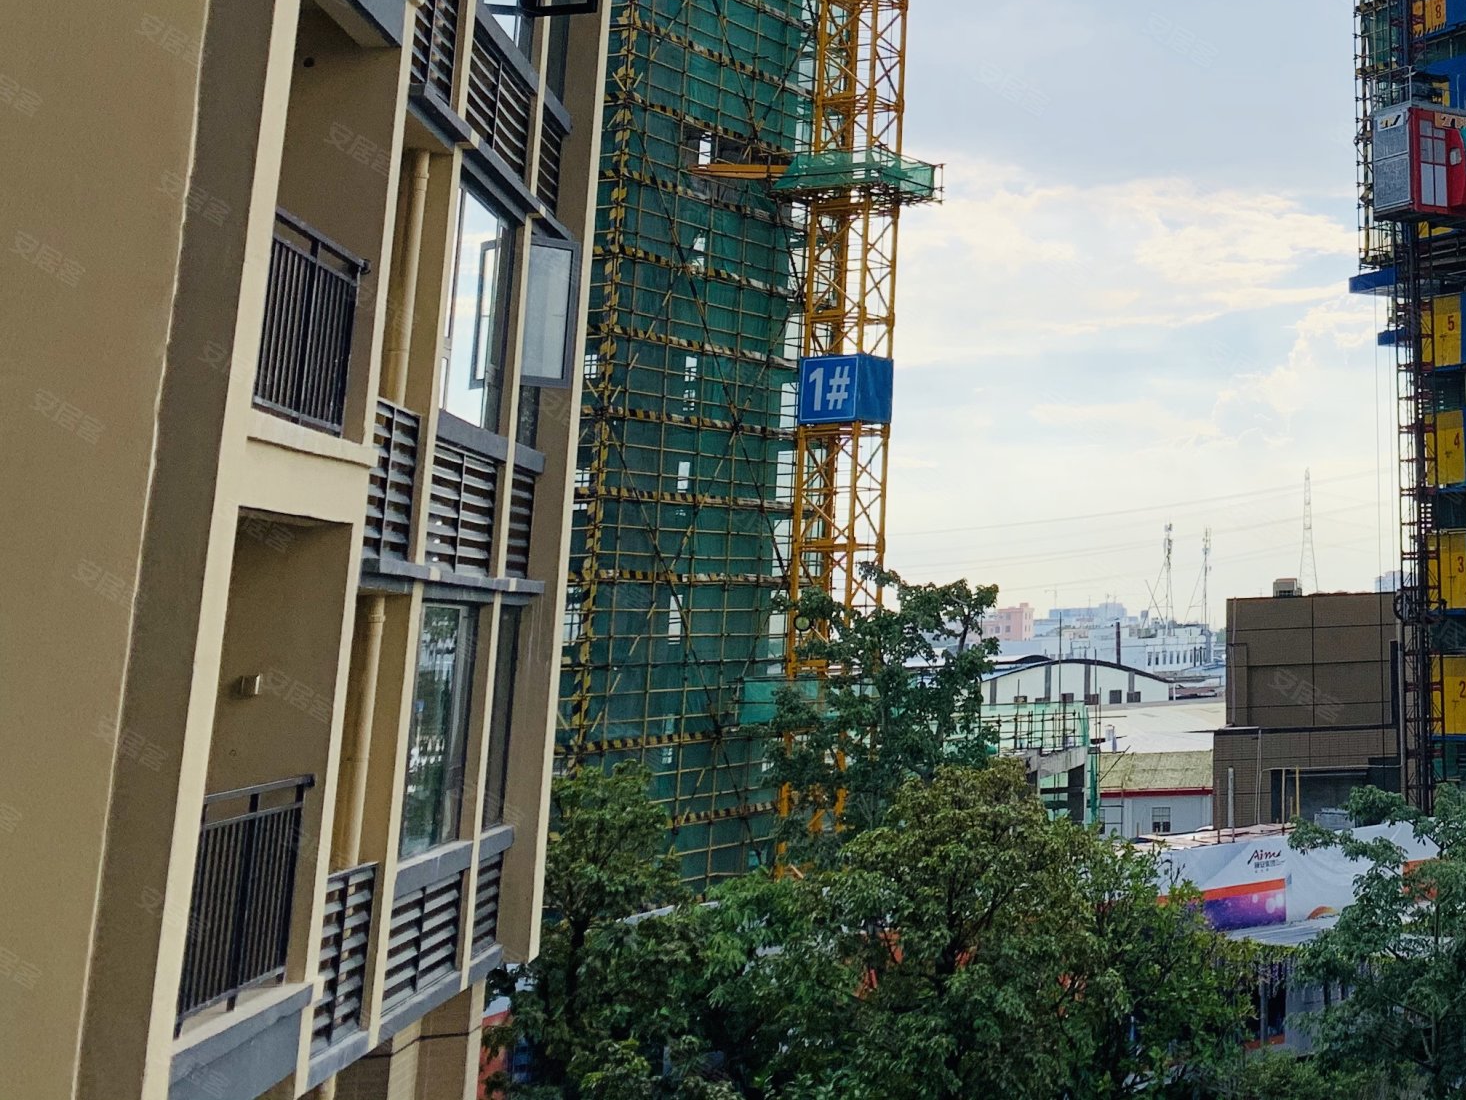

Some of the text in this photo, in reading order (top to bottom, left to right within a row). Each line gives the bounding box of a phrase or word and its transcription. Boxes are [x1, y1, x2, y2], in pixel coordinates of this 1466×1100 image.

[1435, 4, 1442, 19] 8
[1447, 315, 1455, 332] 5
[808, 365, 851, 412] 1#
[1453, 432, 1460, 449] 4
[1457, 556, 1464, 573] 3
[1459, 681, 1466, 698] 2
